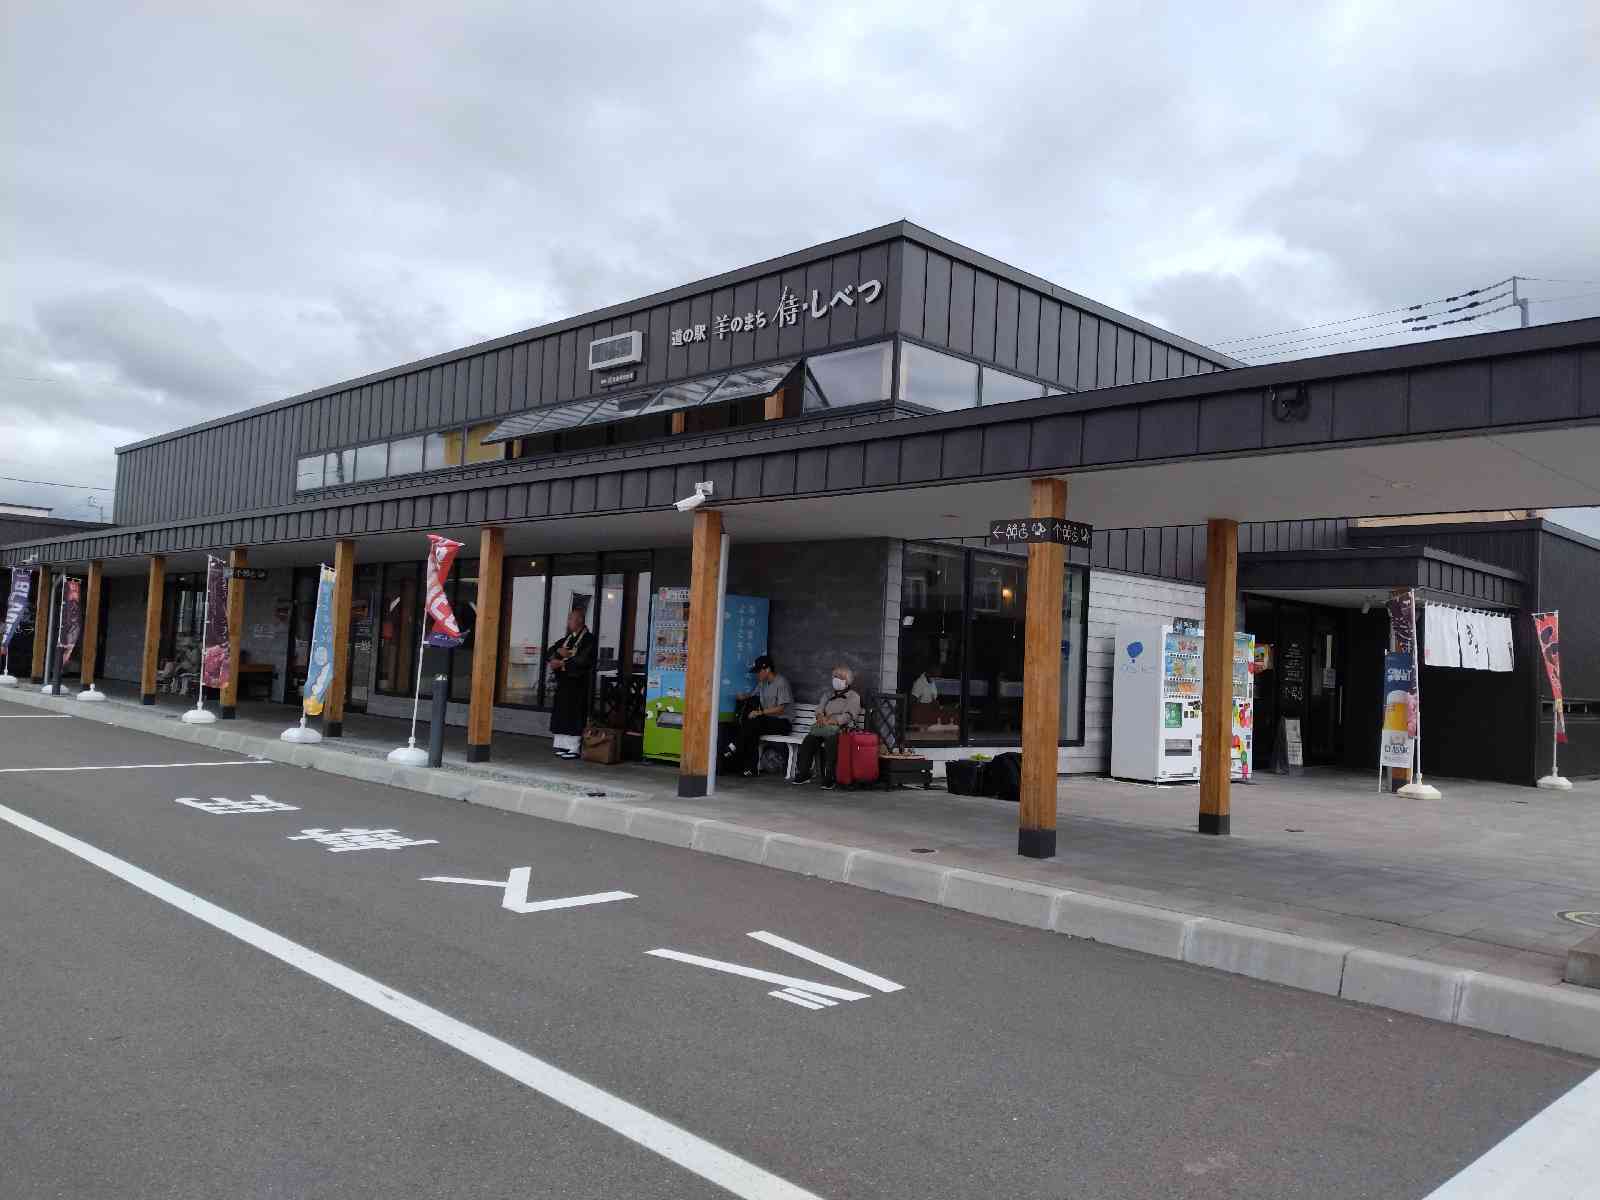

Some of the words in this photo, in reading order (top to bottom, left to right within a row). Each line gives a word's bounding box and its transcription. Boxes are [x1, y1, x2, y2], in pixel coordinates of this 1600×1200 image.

[672, 324, 706, 346] 道の駅
[712, 309, 767, 340] 羊のまち
[174, 794, 905, 1010] バス専用
